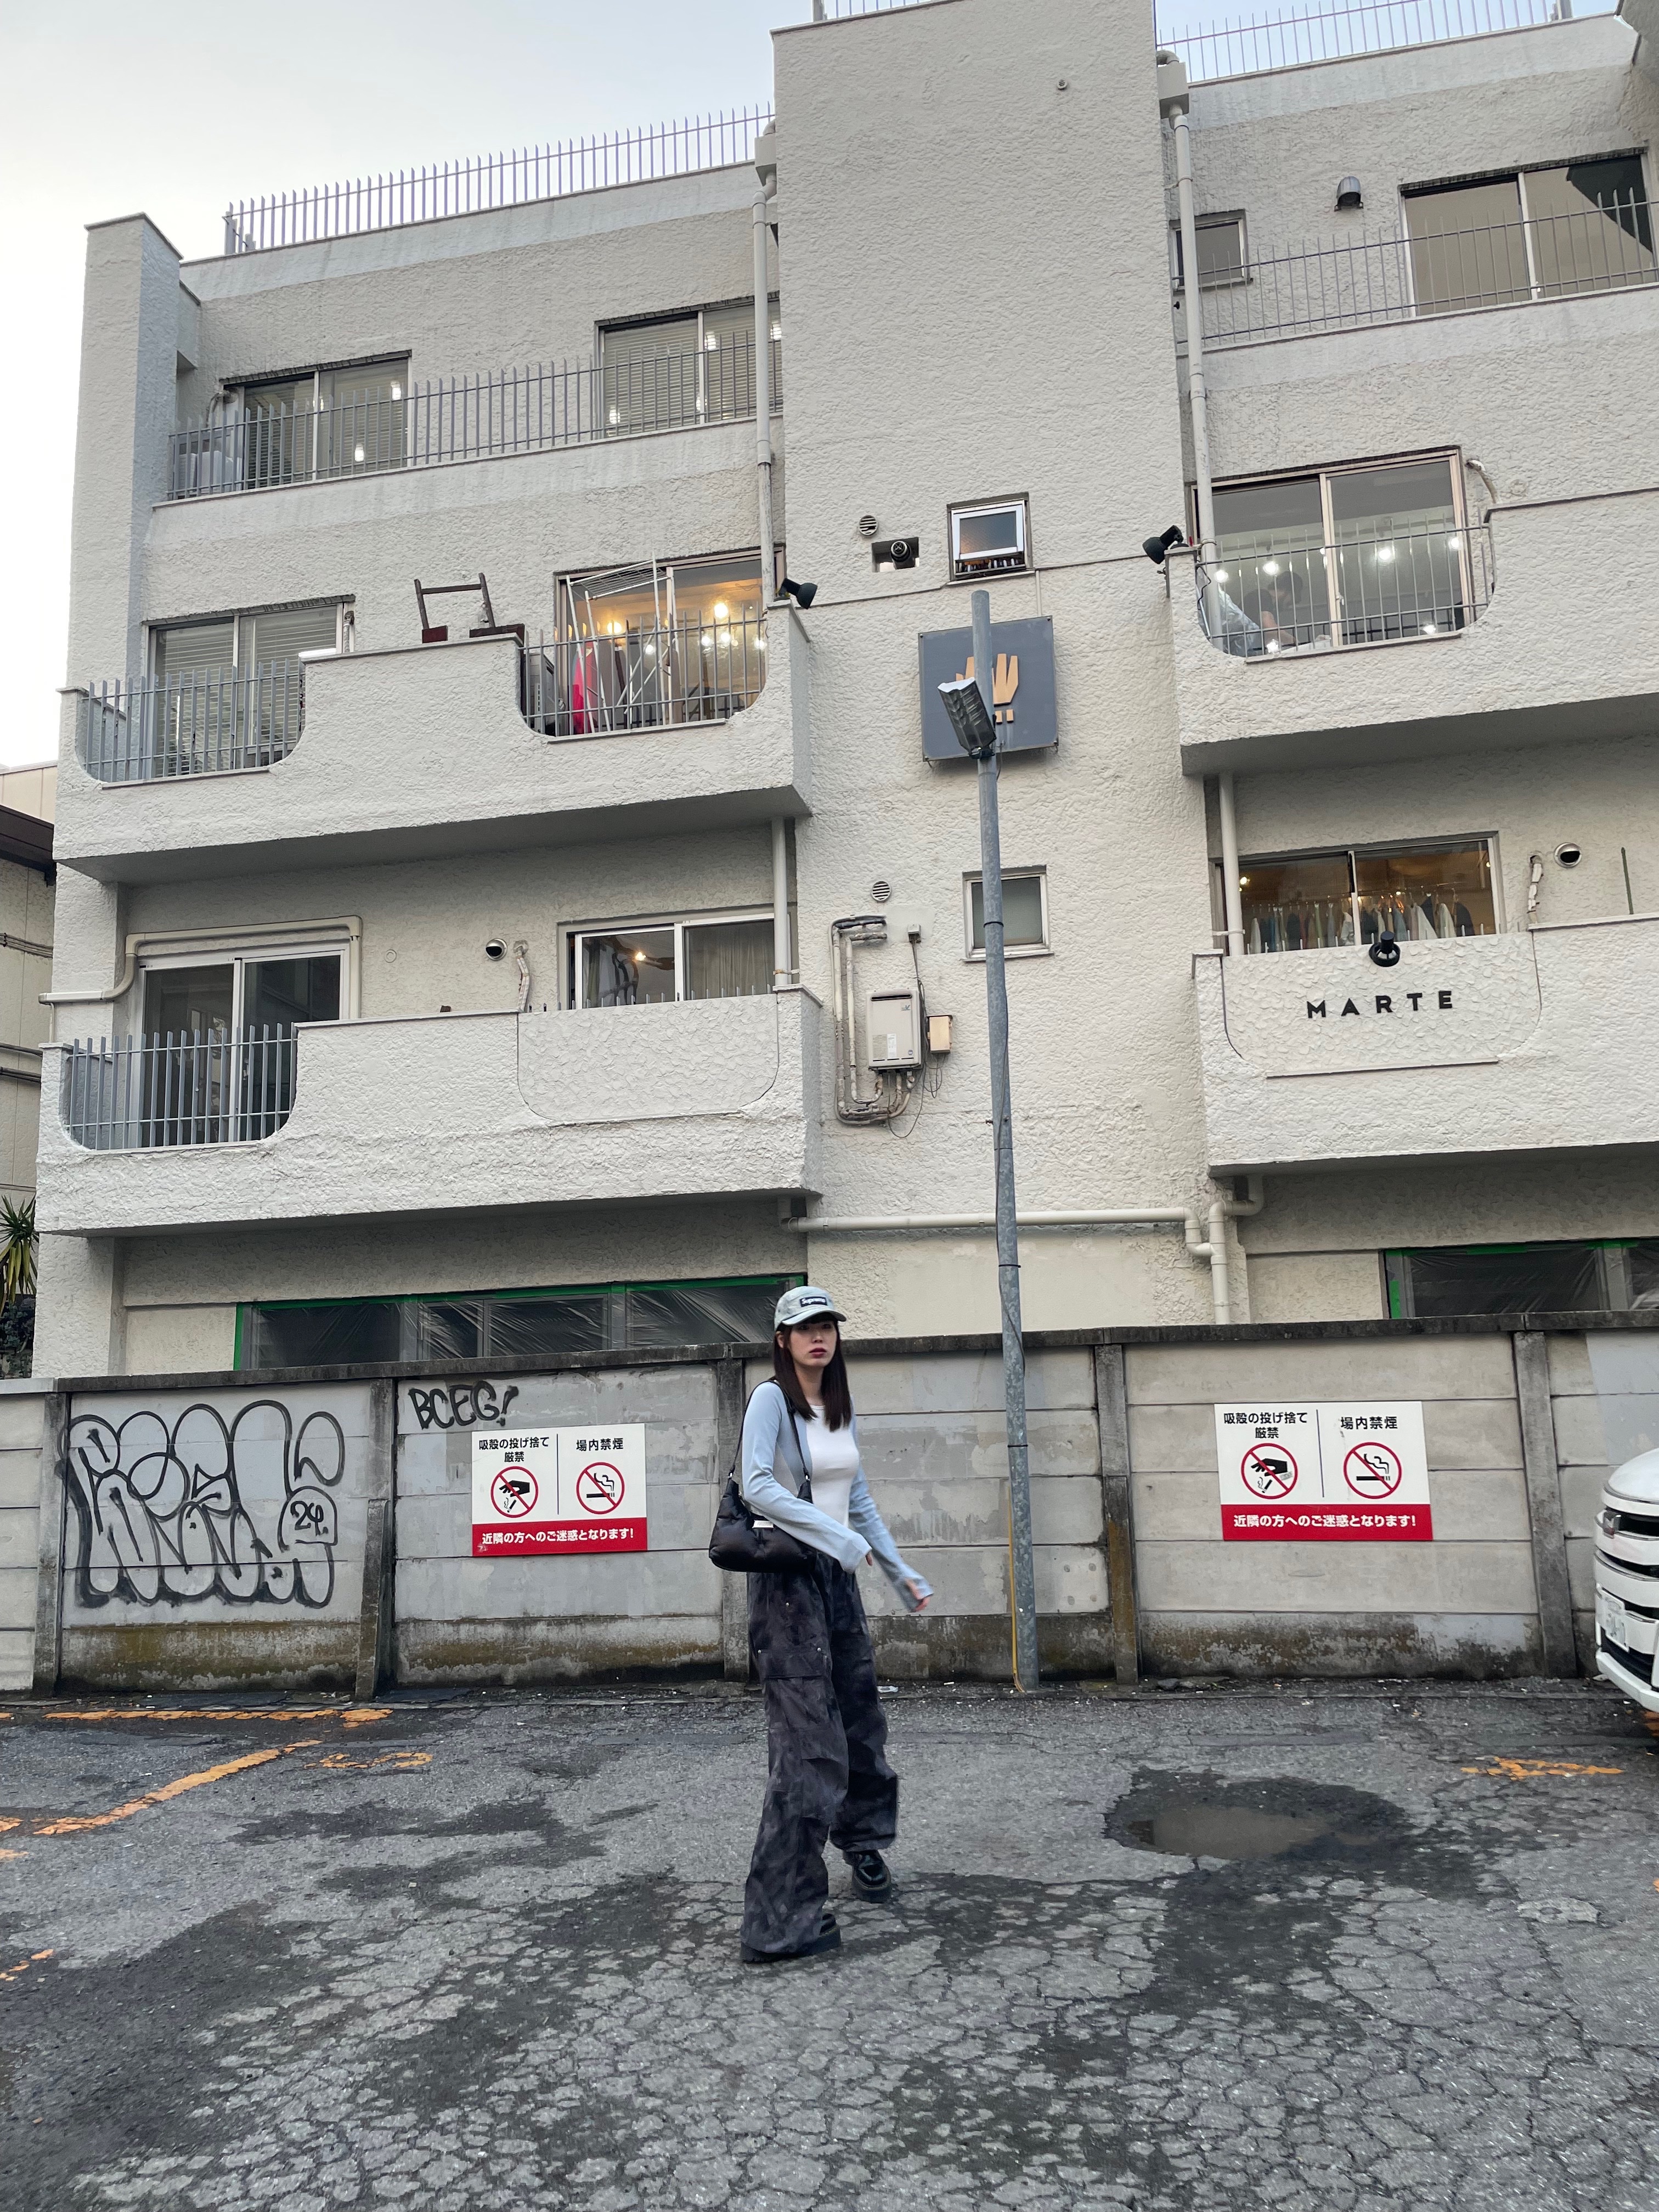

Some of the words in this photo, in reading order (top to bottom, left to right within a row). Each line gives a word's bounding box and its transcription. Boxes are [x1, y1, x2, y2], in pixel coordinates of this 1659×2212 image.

[1306, 990, 1453, 1019] MARTE
[1223, 1412, 1307, 1424] 吸殻の投げ捨て
[1340, 1416, 1398, 1429] 場内禁煙
[1255, 1427, 1279, 1438] 厳禁
[479, 1436, 549, 1450] 吸殻の投げ捨て
[576, 1437, 624, 1451] 場内禁煙
[504, 1451, 524, 1463] 厳禁
